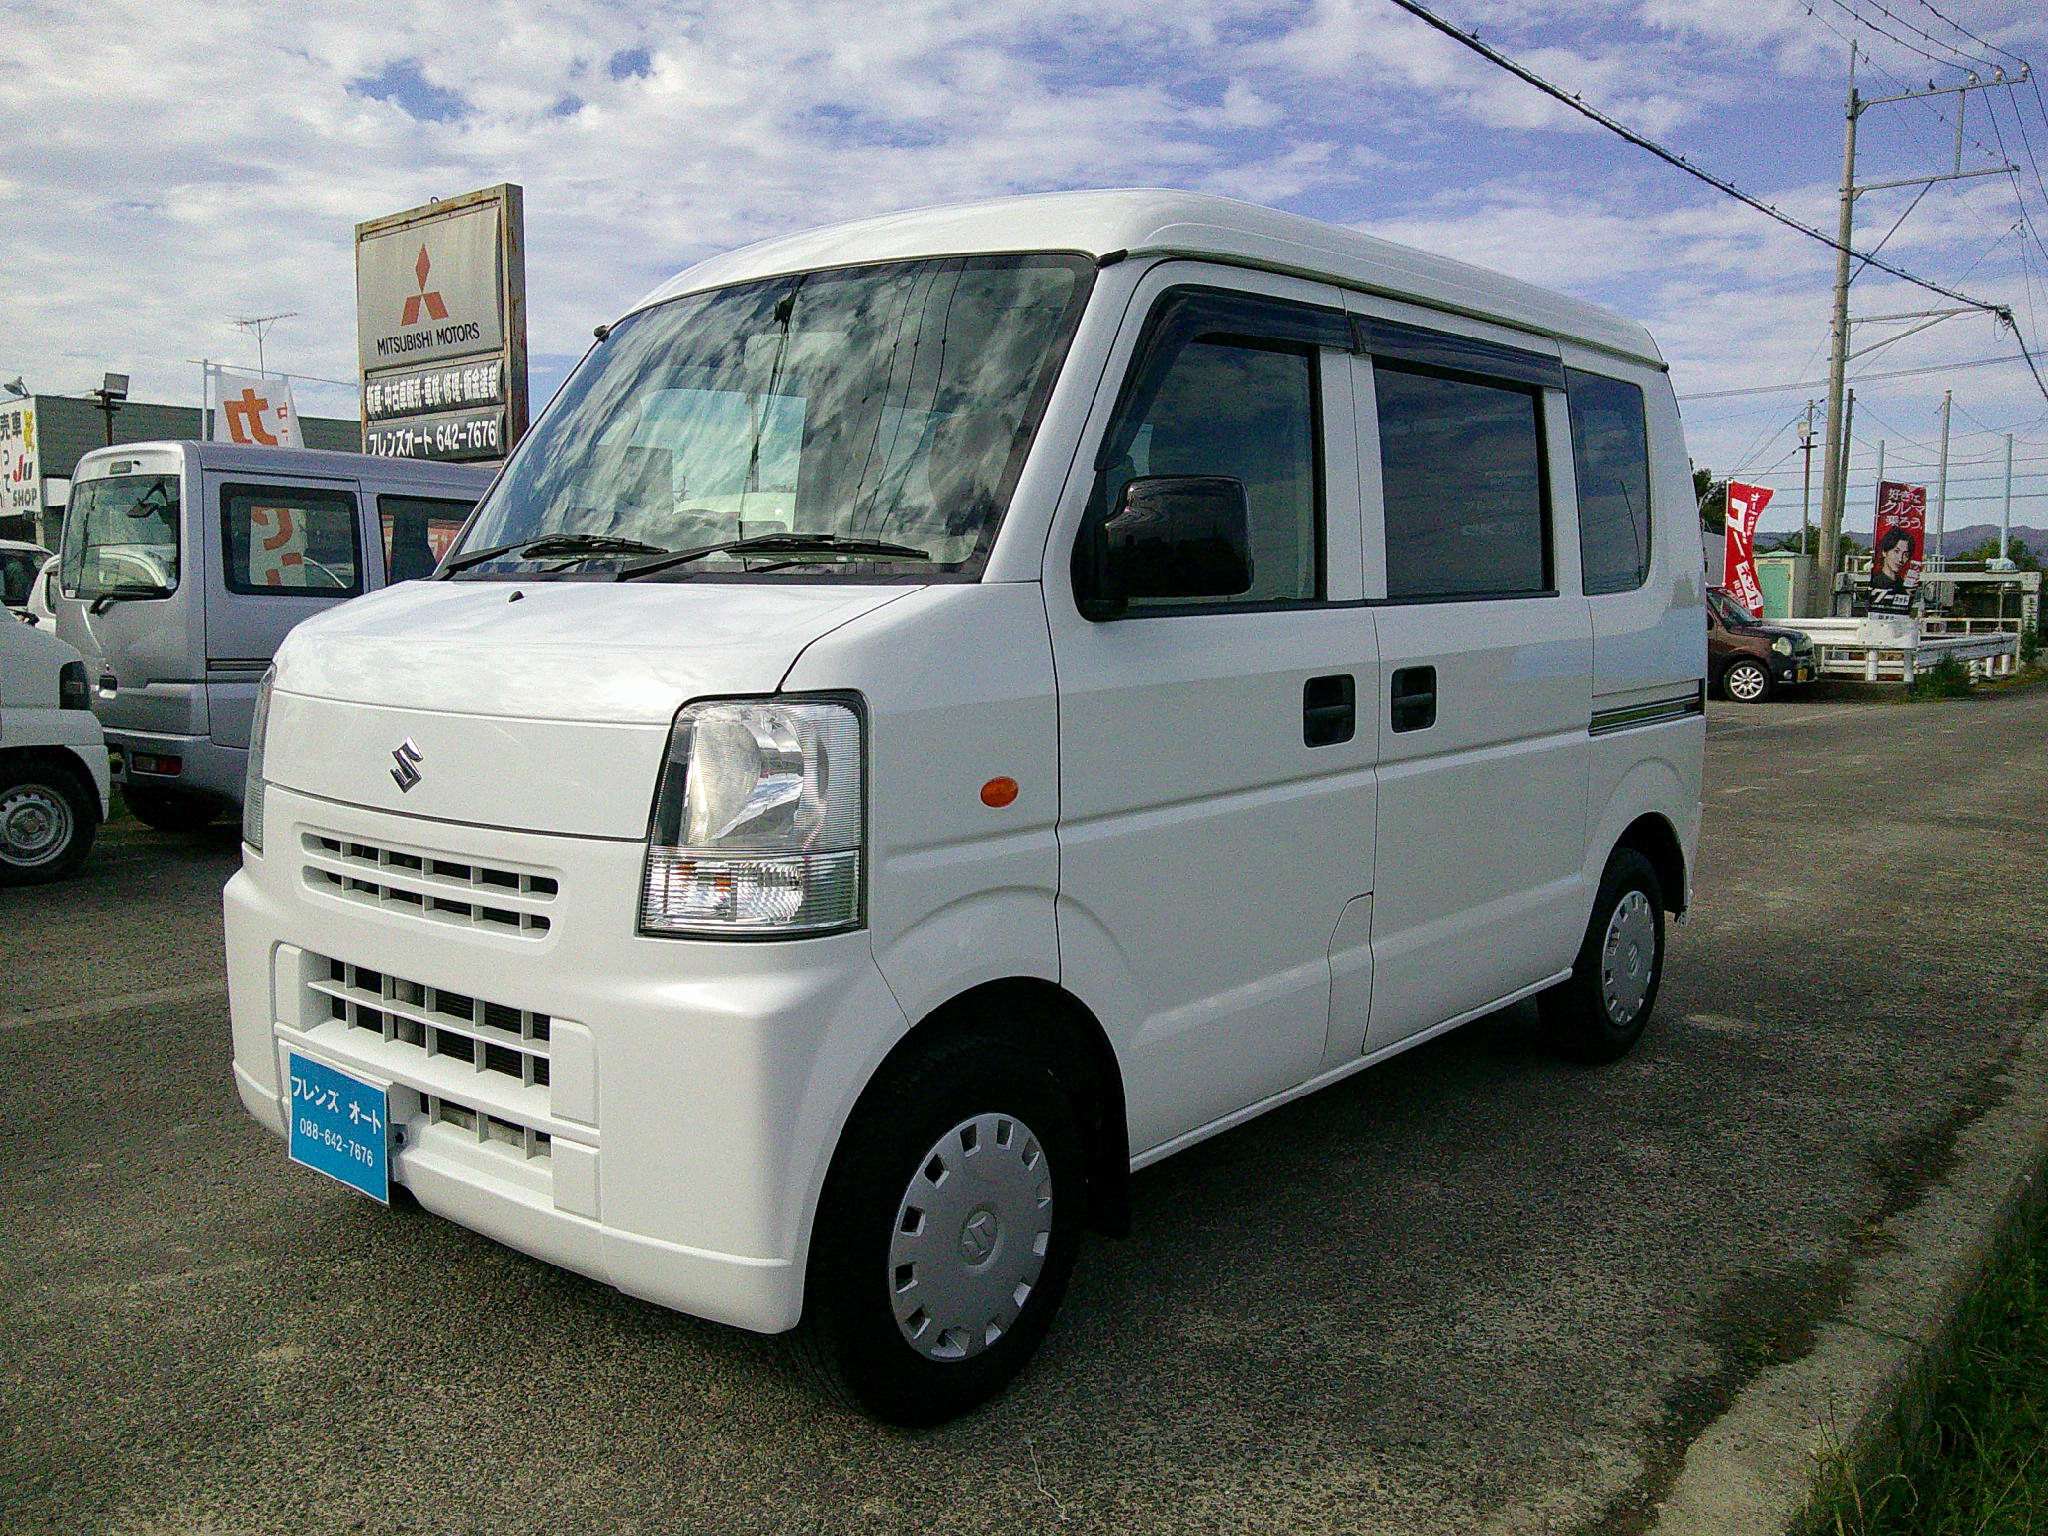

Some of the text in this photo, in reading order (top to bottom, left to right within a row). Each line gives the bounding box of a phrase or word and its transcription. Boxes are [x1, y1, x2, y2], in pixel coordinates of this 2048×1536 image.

[377, 322, 480, 355] MITSUBISHI MOTORS
[369, 420, 497, 457] フレンズオート 642-7676
[13, 487, 37, 507] SHOP
[1880, 500, 1926, 516] クルマ
[291, 1075, 382, 1135] フレンズ オート
[299, 1117, 374, 1168] 088-642-7676
